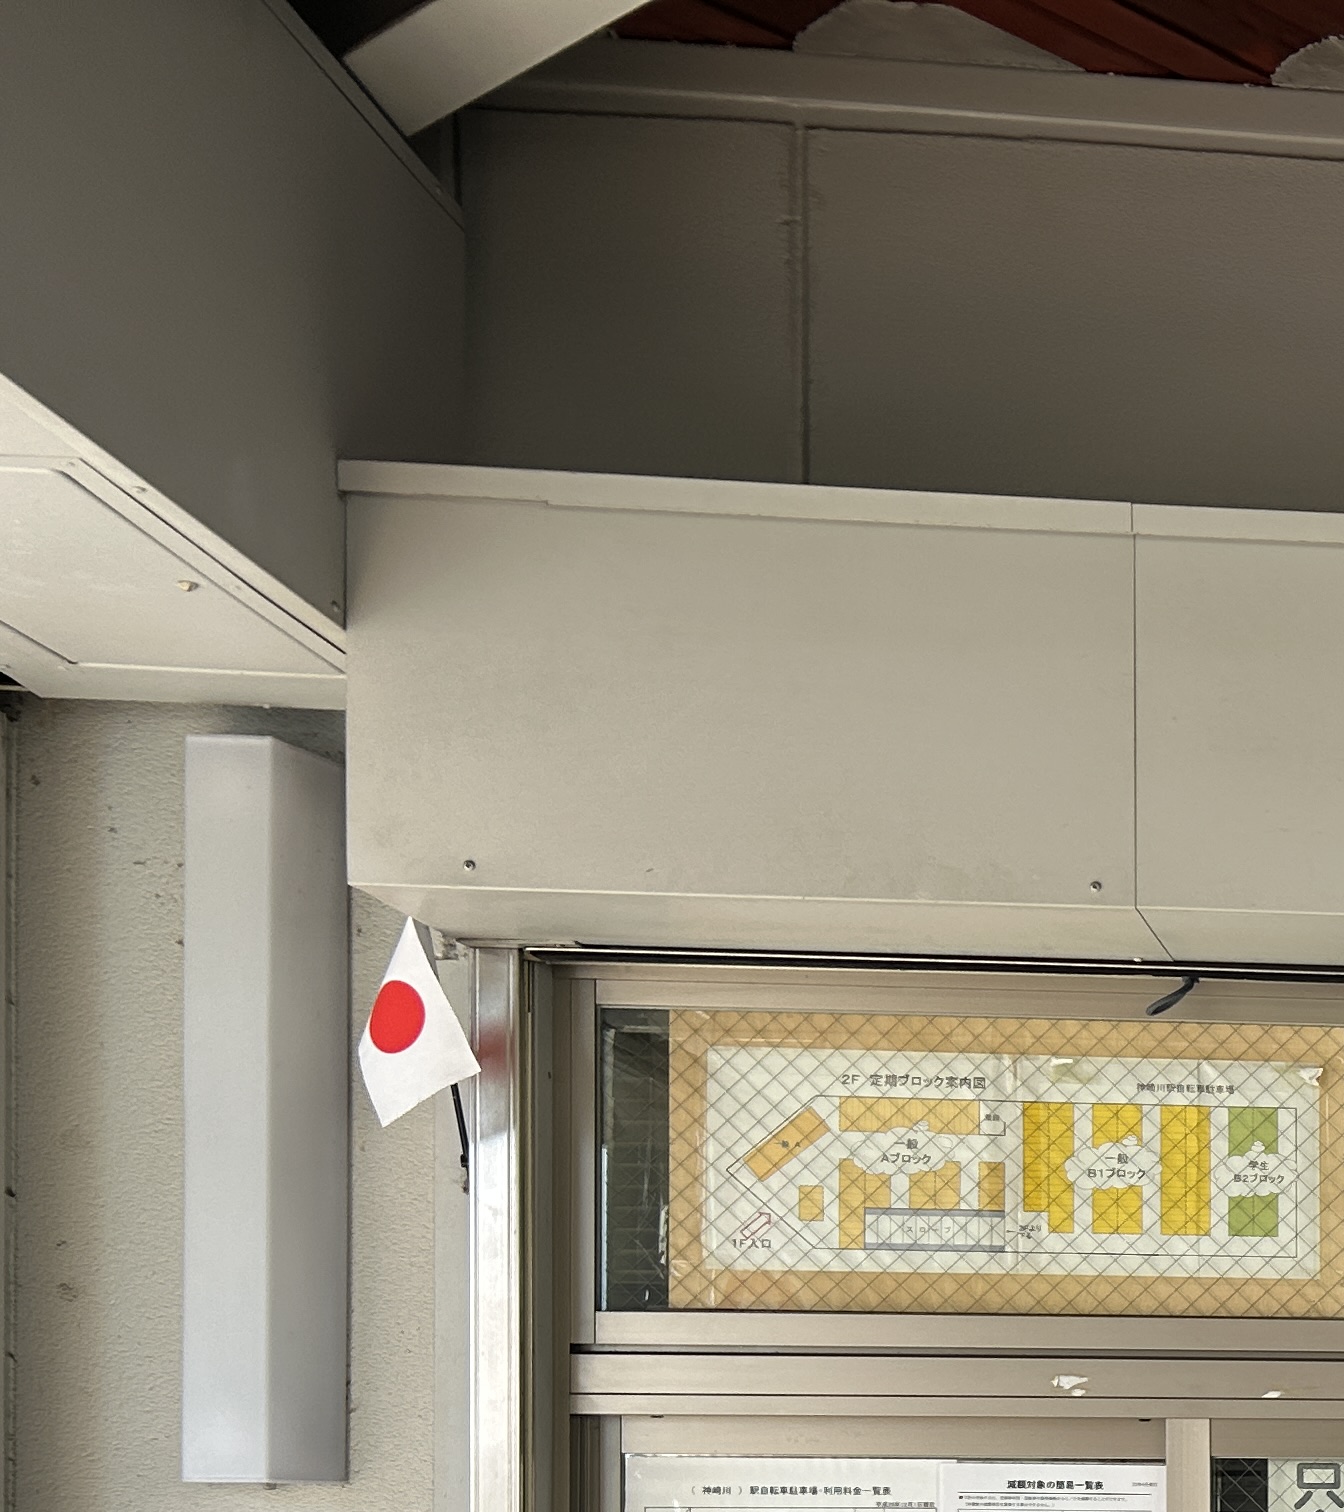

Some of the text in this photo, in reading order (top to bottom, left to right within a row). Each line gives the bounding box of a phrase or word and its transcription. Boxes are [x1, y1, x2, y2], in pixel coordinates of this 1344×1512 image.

[841, 1074, 986, 1089] 2F 定期ブロック案内図
[894, 1138, 918, 1150] 一般
[881, 1153, 931, 1165] Aブロック
[1105, 1153, 1129, 1164] 一般
[1248, 1160, 1269, 1171] 学生
[1087, 1168, 1146, 1180] B1ブロック
[1233, 1173, 1284, 1184] B2ブロック
[731, 1238, 772, 1249] 1F入口
